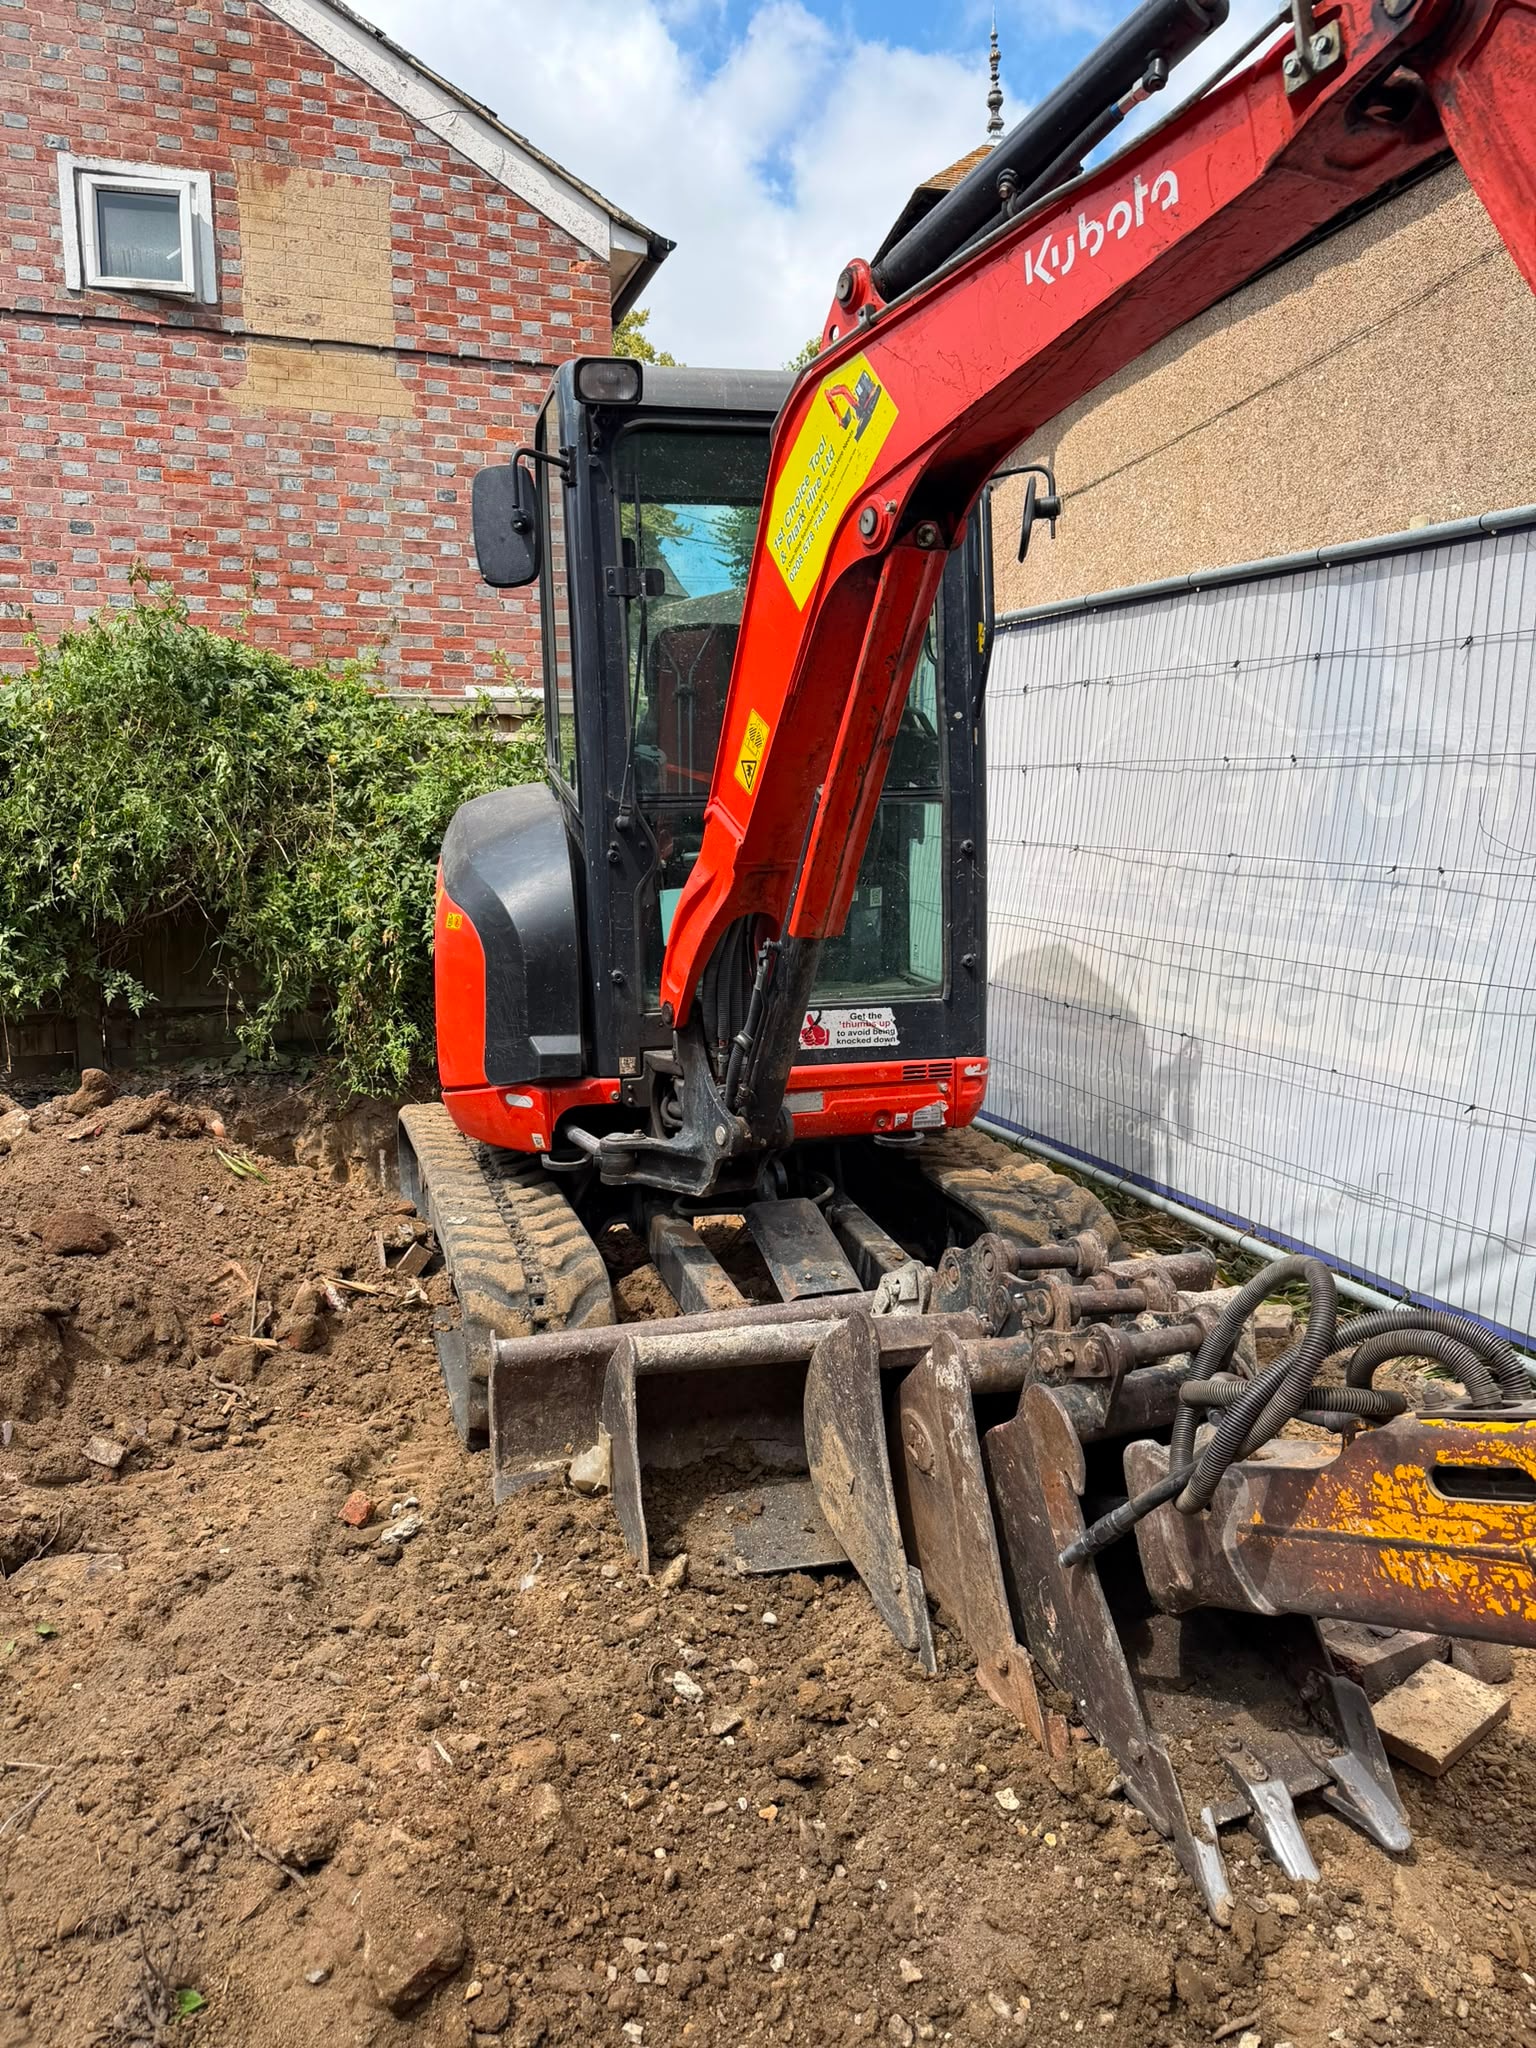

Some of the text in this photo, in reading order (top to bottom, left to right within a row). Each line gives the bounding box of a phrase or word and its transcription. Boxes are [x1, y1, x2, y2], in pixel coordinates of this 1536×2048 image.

[1024, 170, 1179, 286] Kubota
[774, 434, 827, 550] 1st Choice Tool
[780, 550, 787, 565] &
[806, 477, 822, 511] Hire
[821, 444, 835, 477] Ltd
[803, 530, 815, 554] 578
[814, 500, 829, 530] 7444
[836, 1037, 872, 1045] knocked
[848, 1028, 871, 1037] avoid
[850, 1011, 882, 1021] Get the
